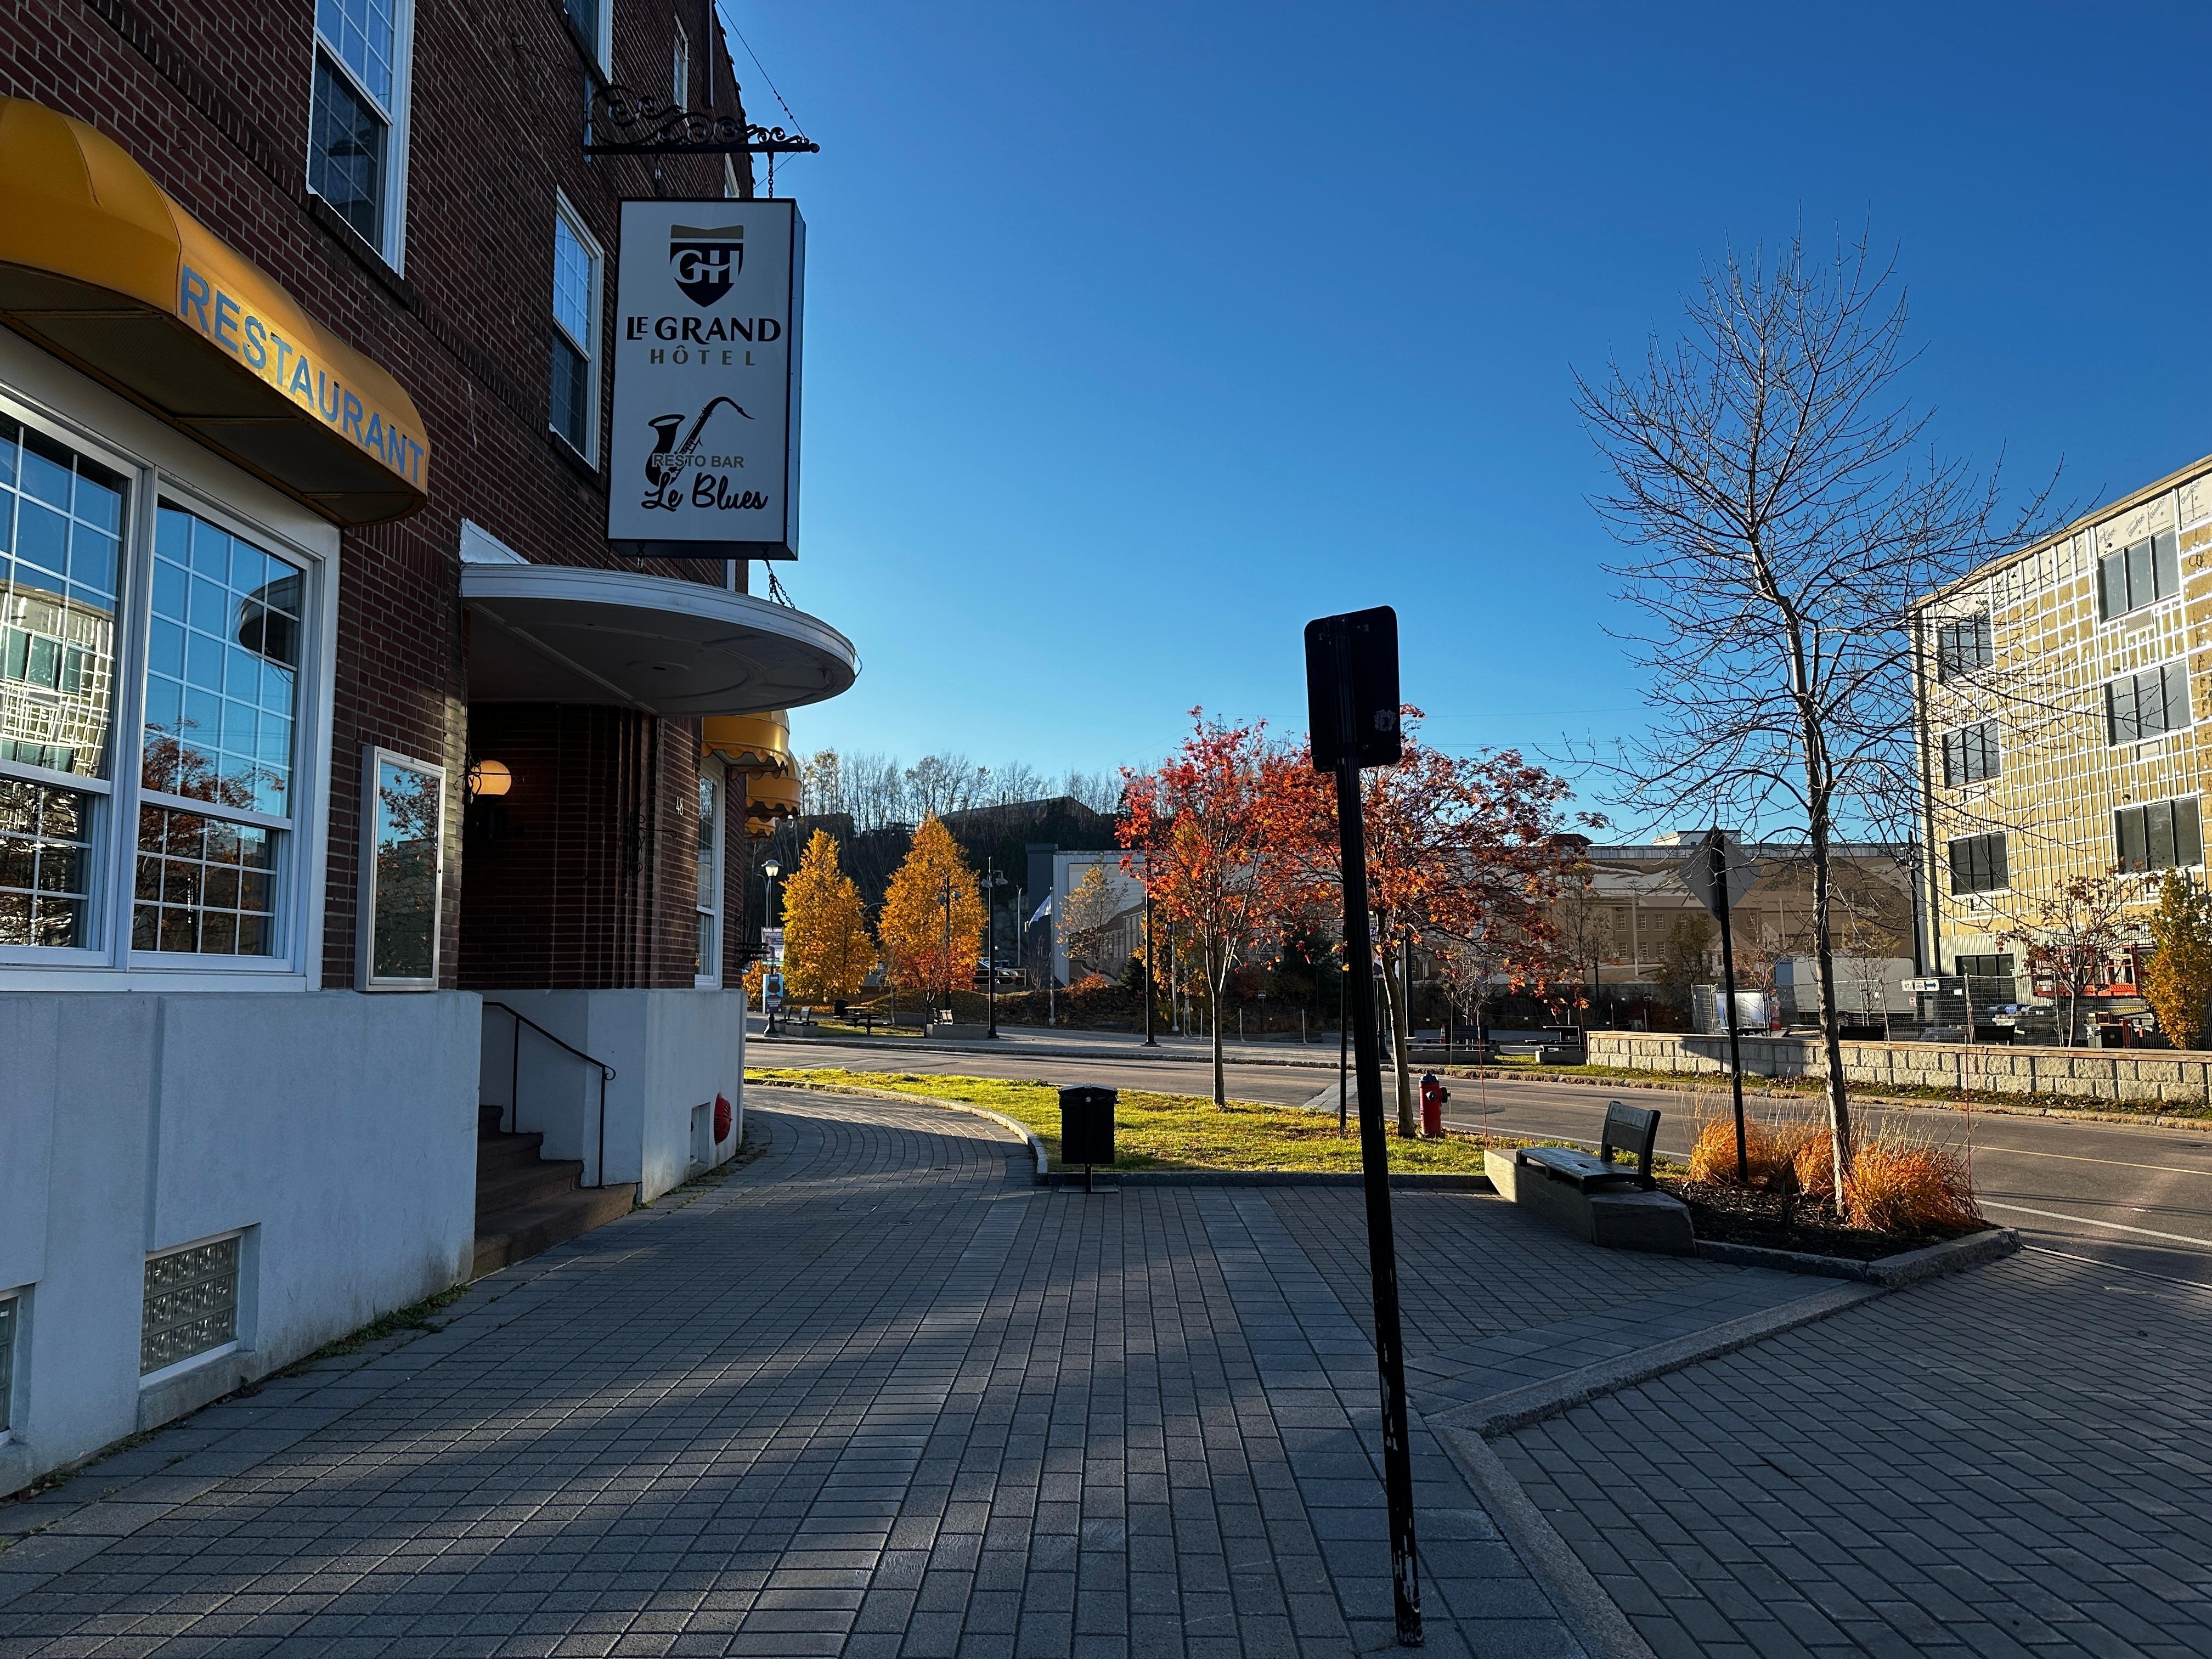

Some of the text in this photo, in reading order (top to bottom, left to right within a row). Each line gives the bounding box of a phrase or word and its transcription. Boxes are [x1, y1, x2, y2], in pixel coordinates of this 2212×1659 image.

[670, 250, 740, 284] GH
[654, 316, 781, 345] GRAND
[650, 345, 755, 365] HÔTEL
[180, 263, 425, 483] RESTAURANT
[652, 453, 744, 468] RESTO BAR
[641, 471, 768, 512] Le Blues
[676, 796, 683, 816] 48
